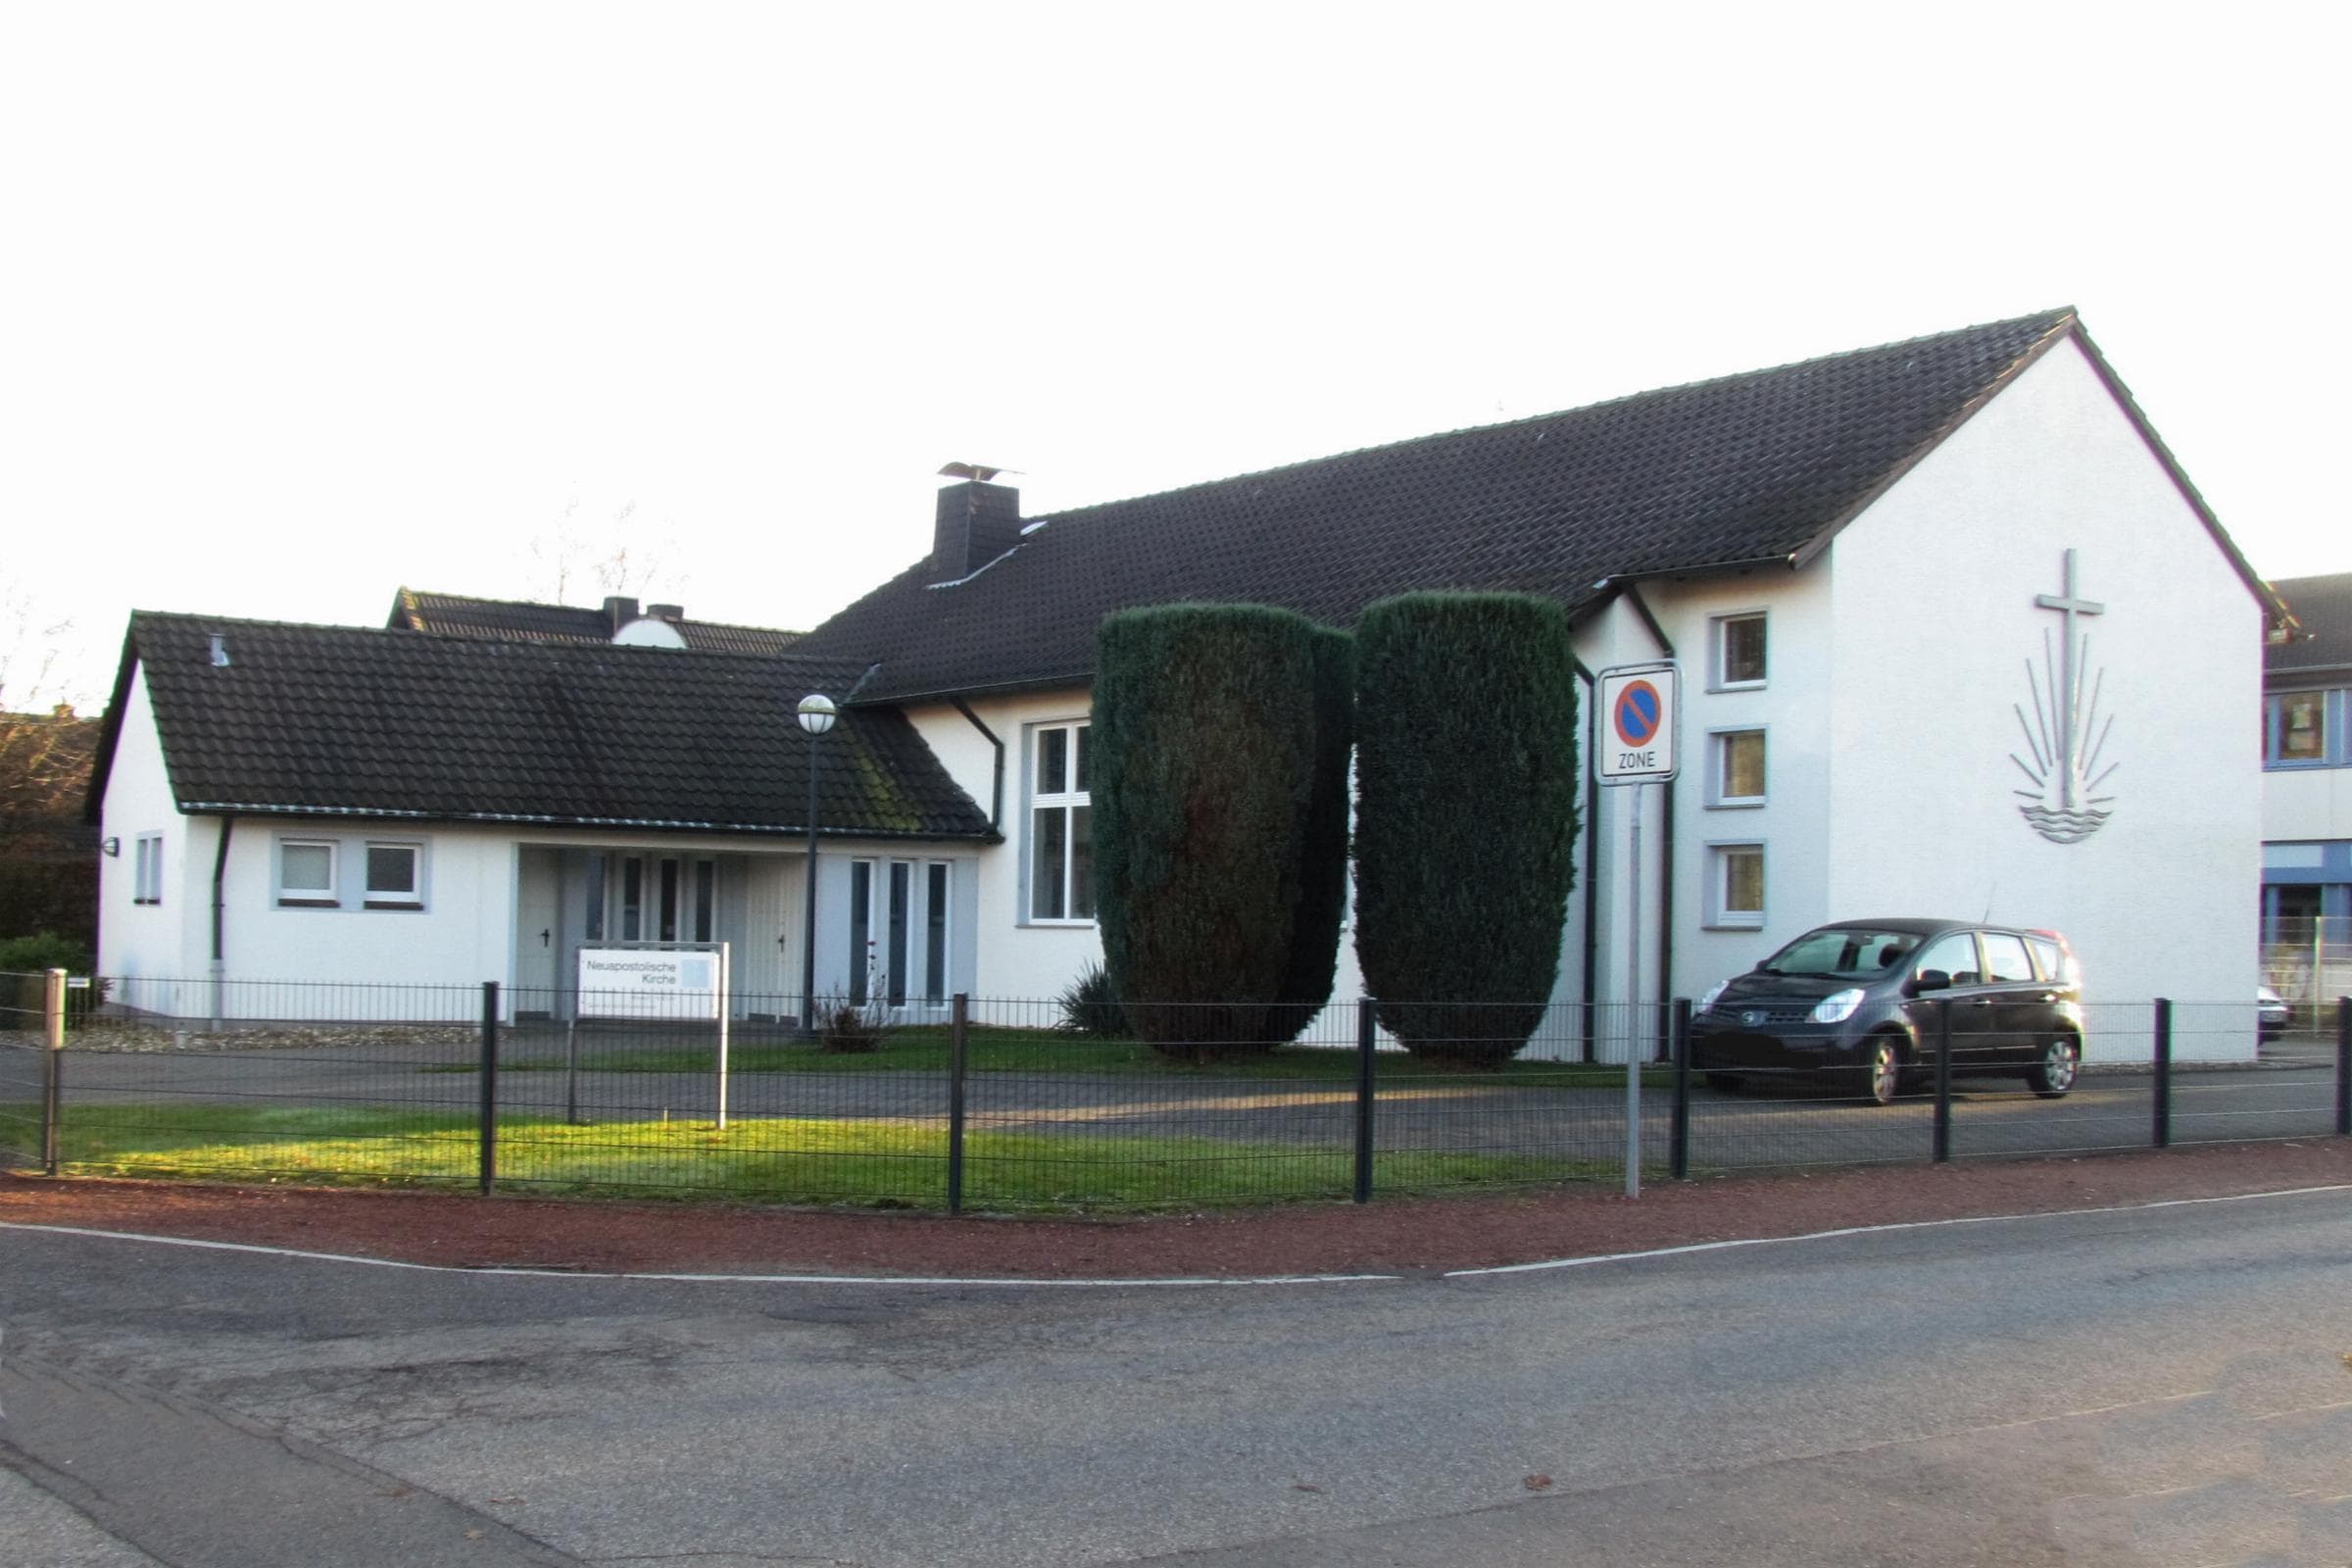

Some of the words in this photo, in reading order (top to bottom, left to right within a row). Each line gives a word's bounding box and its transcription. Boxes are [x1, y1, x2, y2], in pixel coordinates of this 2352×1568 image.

[1618, 751, 1655, 769] ZONE
[586, 960, 676, 972] Neuapostolische
[642, 973, 676, 985] Kirche
